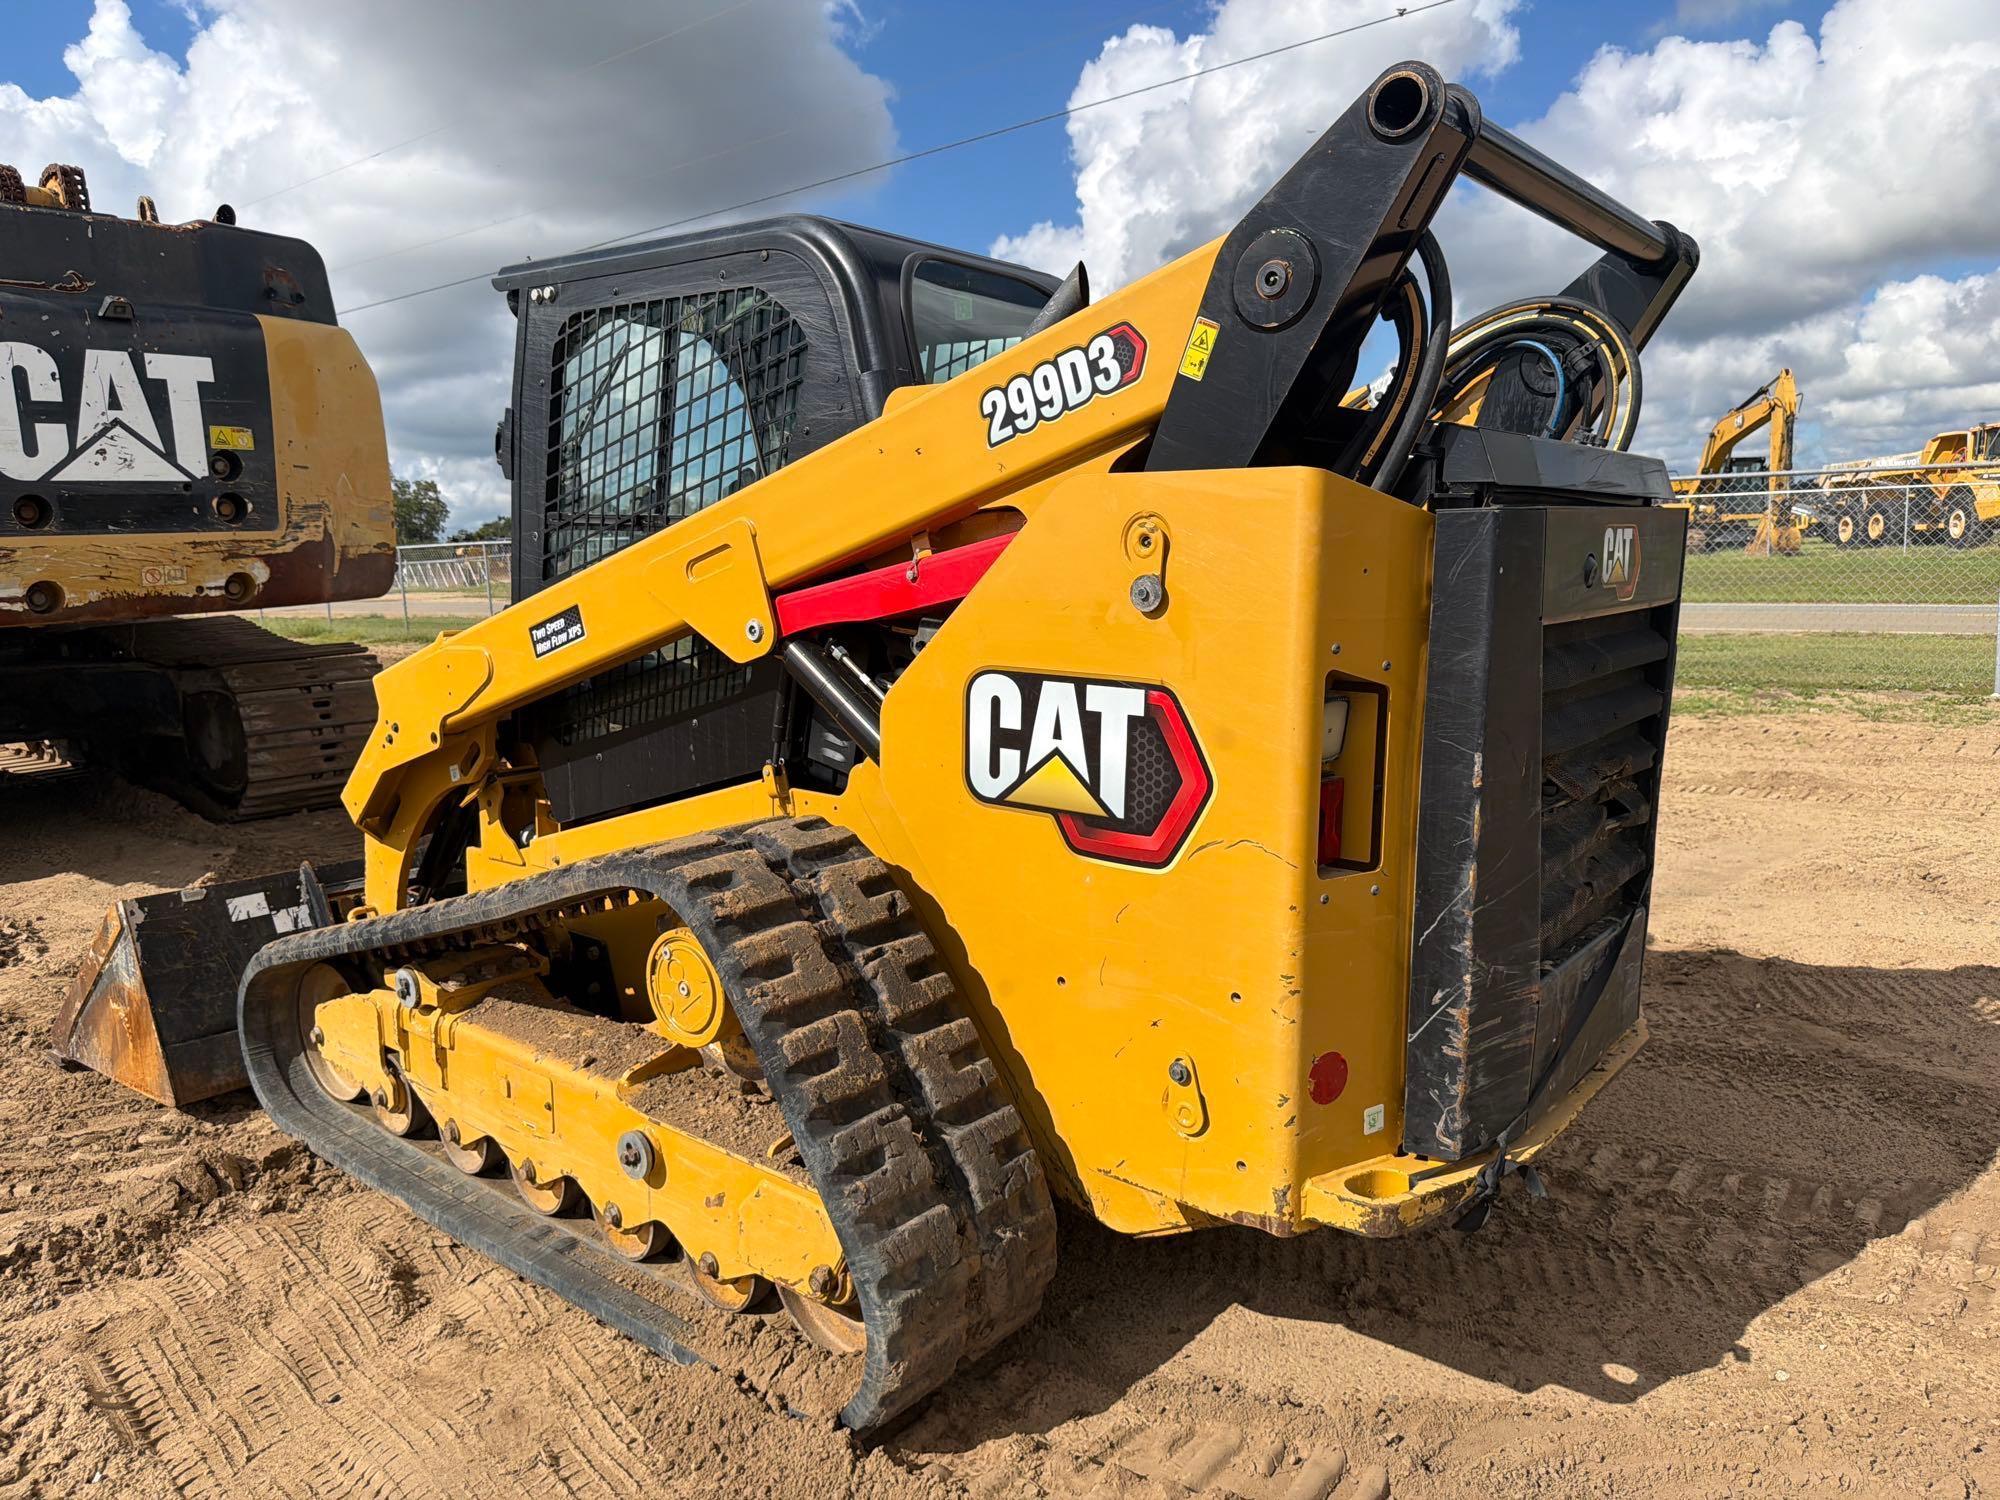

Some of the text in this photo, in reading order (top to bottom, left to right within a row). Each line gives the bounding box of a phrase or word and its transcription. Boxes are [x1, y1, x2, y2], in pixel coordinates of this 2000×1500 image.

[0, 341, 216, 482] CAT
[983, 335, 1122, 445] 299D3
[1602, 527, 1633, 583] CAT
[567, 623, 582, 639] XPS
[969, 673, 1146, 819] CAT
